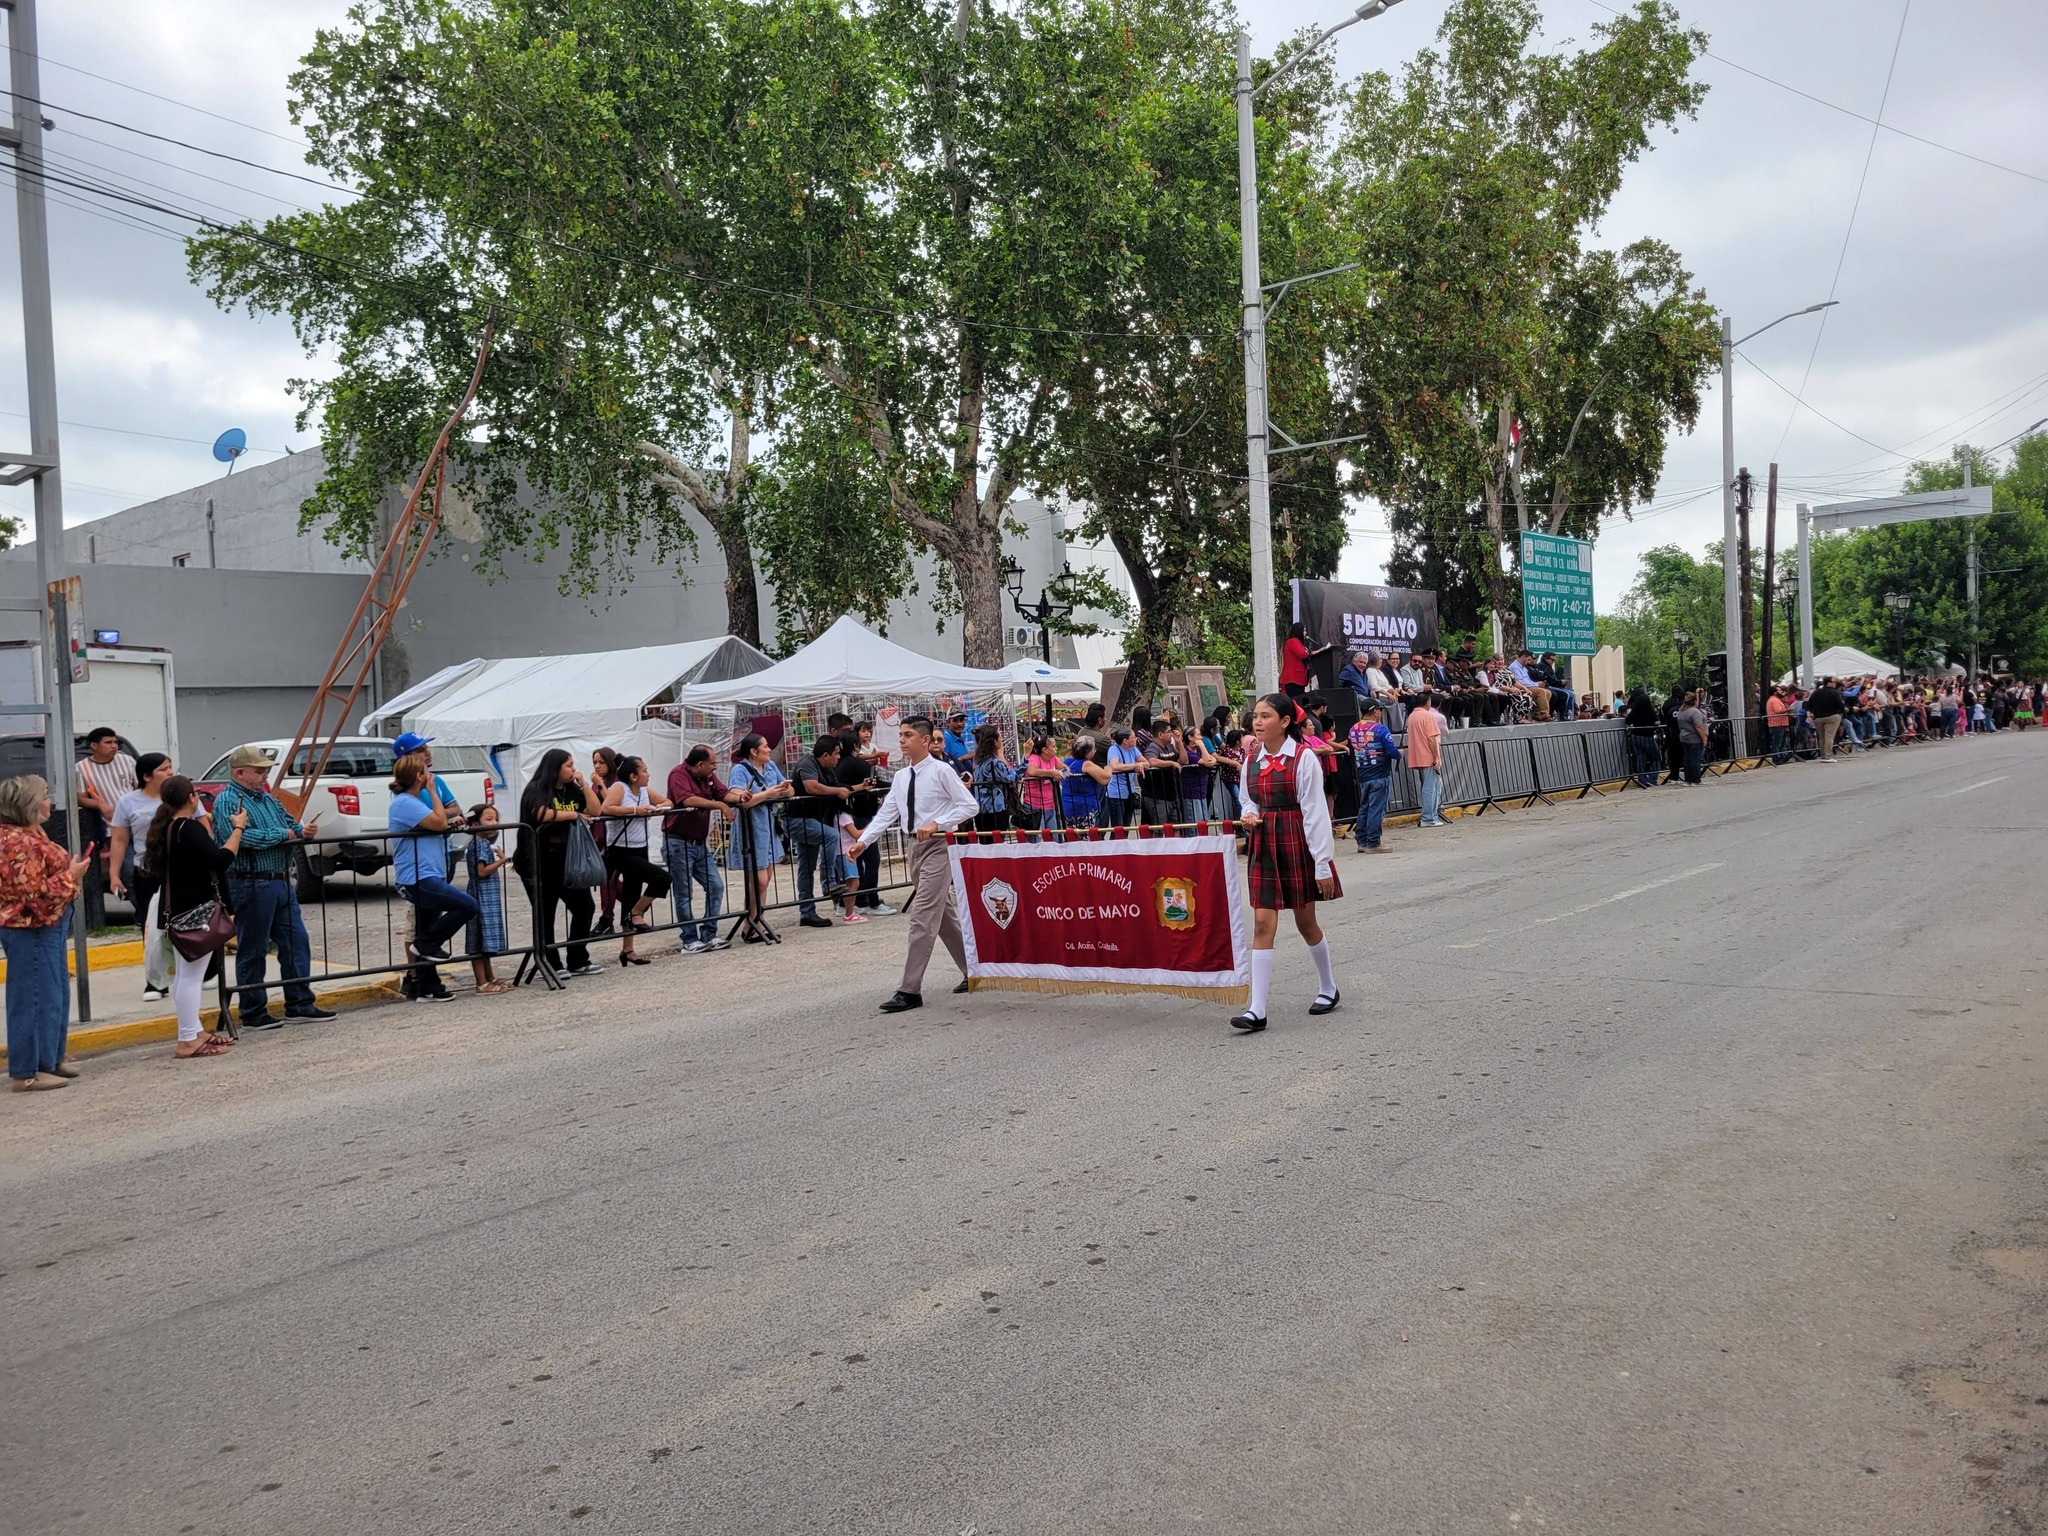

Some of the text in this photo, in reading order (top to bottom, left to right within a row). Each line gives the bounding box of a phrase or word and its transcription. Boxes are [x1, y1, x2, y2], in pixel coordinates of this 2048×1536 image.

[1535, 554, 1552, 567] WELCOME
[1553, 557, 1558, 568] TO
[1528, 594, 1591, 614] (91-877) 2-40-72
[1343, 614, 1417, 639] 5 DE MAYO
[1531, 616, 1590, 628] DELEGACION DE TURISMO
[1528, 627, 1545, 636] PUERTA
[1546, 628, 1553, 637] DE
[1554, 629, 1571, 637] MEXICO
[1529, 639, 1547, 648] GOBIERNO
[1572, 641, 1576, 649] DE
[1032, 862, 1076, 894] ESCUELA
[1078, 862, 1132, 894] PRIMARIA
[1036, 904, 1140, 920] CINCO DE MAYO
[1065, 942, 1075, 950] Cd.
[1078, 941, 1095, 951] Acuña,
